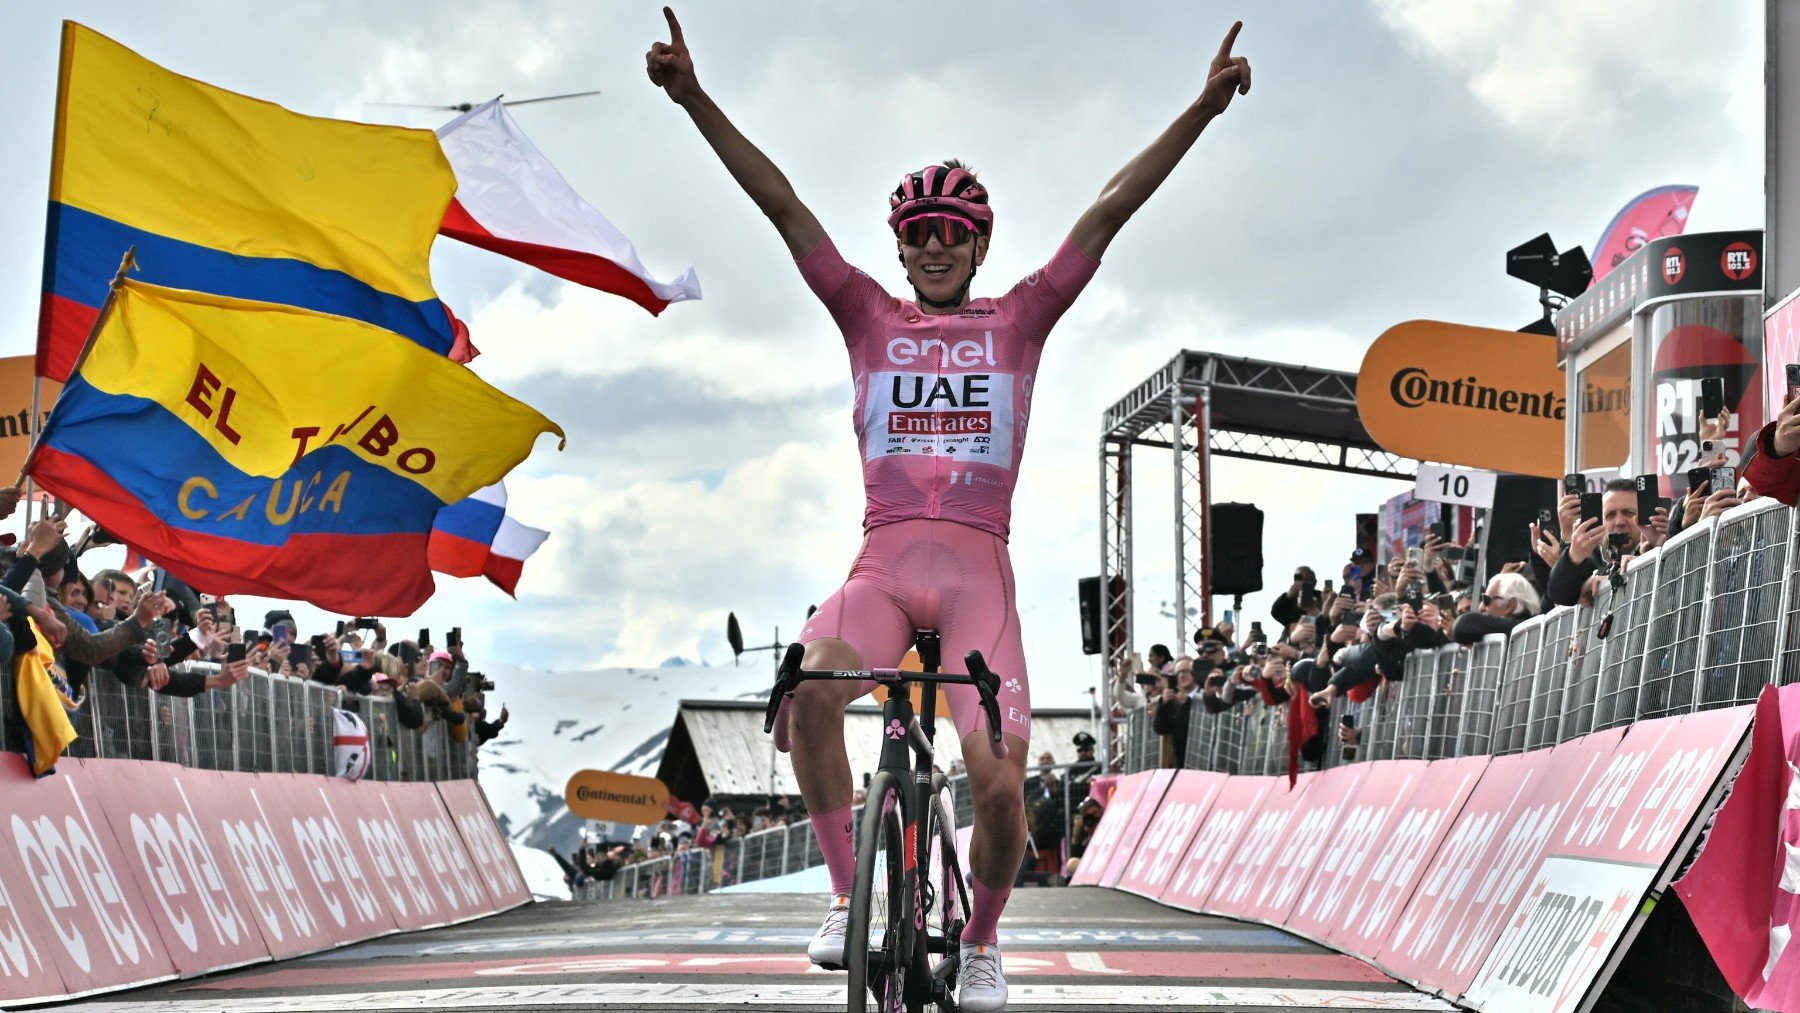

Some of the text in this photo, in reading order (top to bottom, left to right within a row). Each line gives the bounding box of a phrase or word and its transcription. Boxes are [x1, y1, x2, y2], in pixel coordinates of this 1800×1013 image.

[1666, 257, 1680, 268] RTL
[1727, 251, 1750, 262] RTL
[1727, 262, 1751, 270] 102.5
[887, 331, 997, 367] enel
[893, 375, 990, 409] UAE
[185, 362, 436, 475] EL TBO
[892, 413, 989, 432] Emirates
[1656, 438, 1741, 477] 1025
[1438, 473, 1470, 498] 10
[577, 786, 646, 805] Continental
[1130, 783, 1217, 885] enel
[1173, 787, 1264, 897] enel
[1565, 725, 1673, 848] enel
[1618, 717, 1742, 852] enel
[11, 775, 154, 973] enel
[130, 777, 251, 952] enel
[222, 788, 319, 942] enel
[292, 787, 384, 928] enel
[358, 793, 438, 918] enel
[413, 793, 484, 910] enel
[459, 788, 521, 898] enel
[1215, 783, 1312, 904] enel
[1256, 775, 1358, 910] enel
[1300, 775, 1412, 923] enel
[1343, 773, 1470, 940] enel
[1393, 768, 1533, 960] enel
[1439, 752, 1601, 976] enel
[1498, 892, 1604, 997] TUDOR
